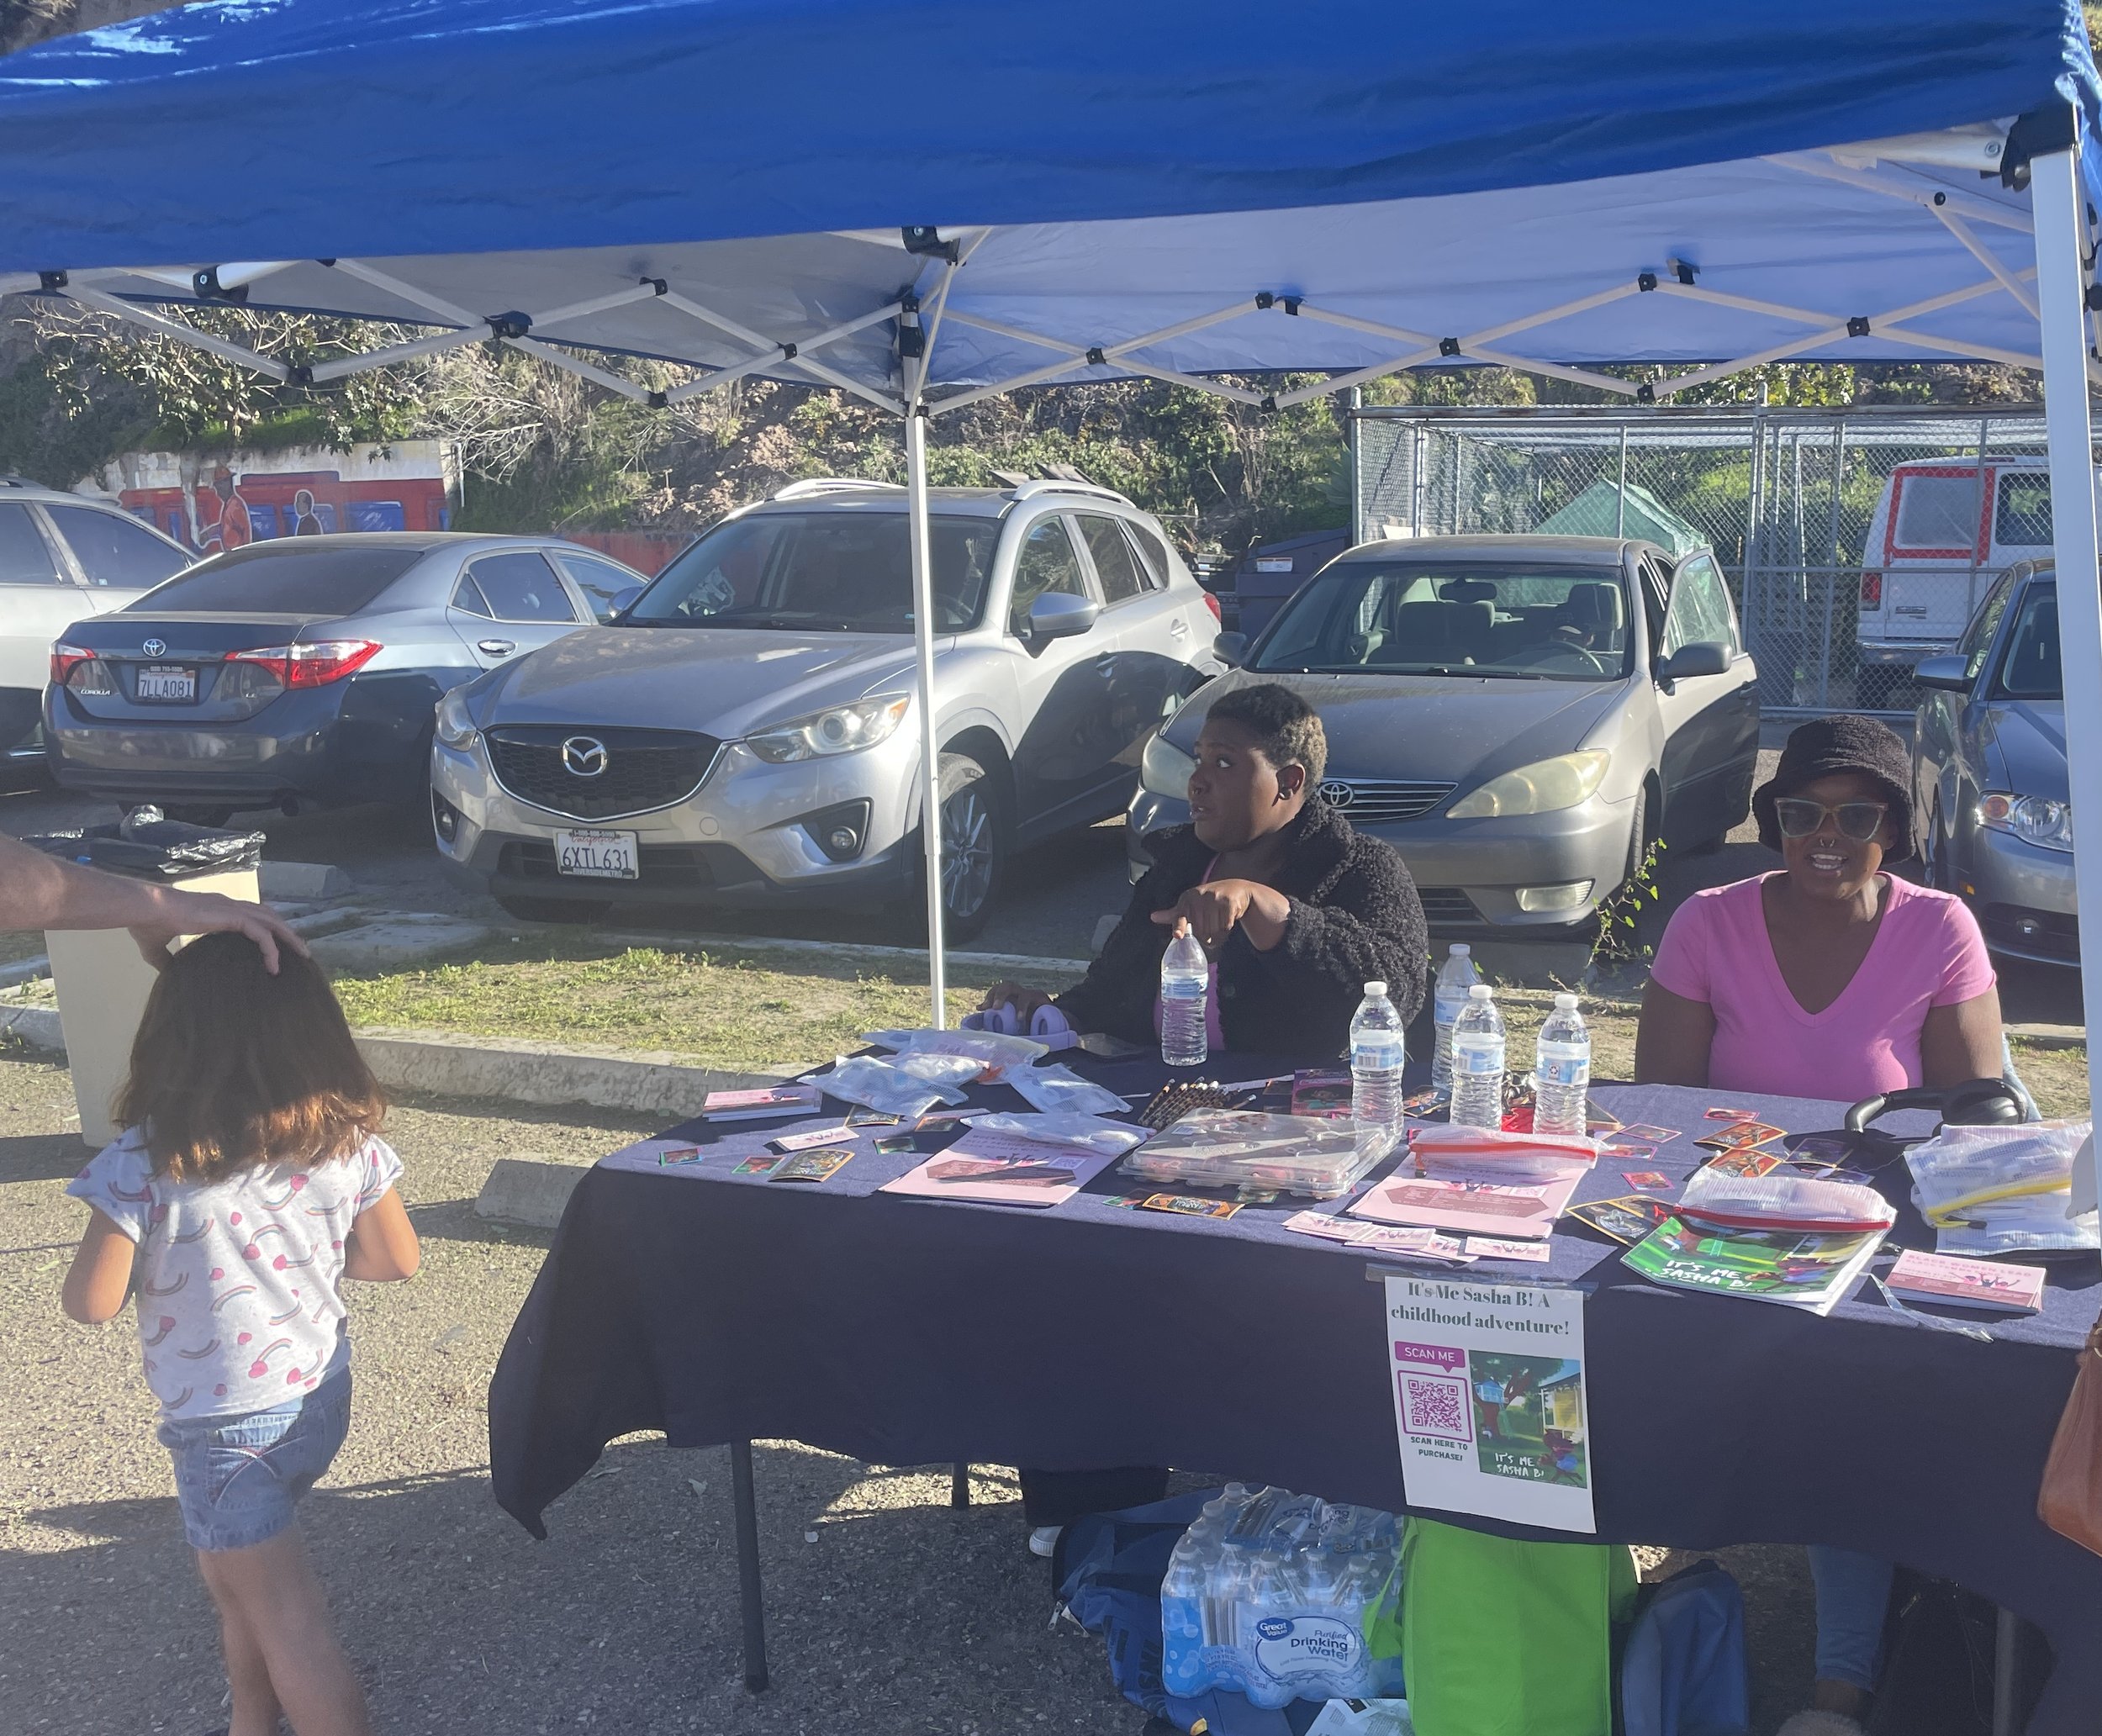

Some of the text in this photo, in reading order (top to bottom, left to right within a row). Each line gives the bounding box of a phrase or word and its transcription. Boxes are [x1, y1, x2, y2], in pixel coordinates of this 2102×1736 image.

[80, 688, 111, 696] COROLLA
[140, 679, 192, 698] 7LLA081
[562, 847, 629, 871] 6XTL631
[1660, 1267, 1721, 1285] SASHA
[1666, 1260, 1742, 1279] IT'S ME
[1407, 1281, 1550, 1308] It's Me Sasha B! A
[1391, 1305, 1570, 1335] childhood adventure!
[1404, 1347, 1455, 1363] SCAN ME
[1410, 1436, 1468, 1451] SCAN HERE TO
[1418, 1448, 1463, 1462] PURCHASE!
[1494, 1452, 1535, 1467] IT'S ME
[1497, 1464, 1529, 1477] SASHA
[1260, 1622, 1287, 1632] Great
[1314, 1629, 1347, 1640] Purified
[1291, 1638, 1348, 1652] Drinking
[1307, 1646, 1349, 1662] Water
